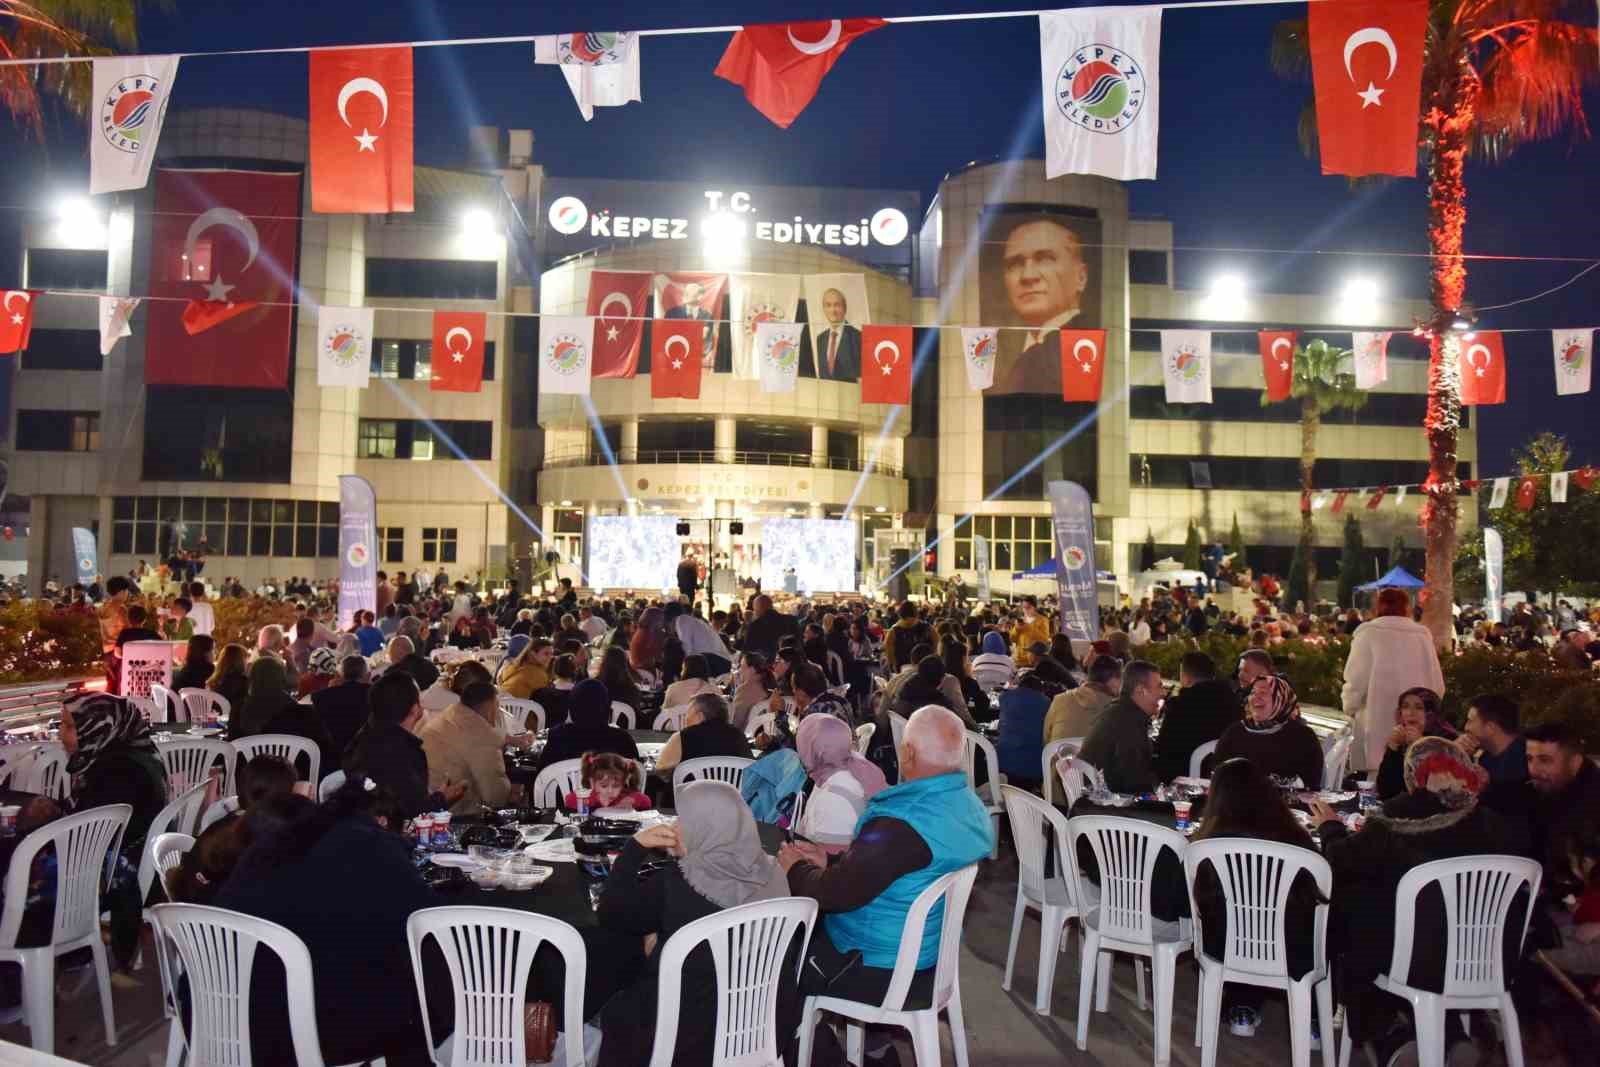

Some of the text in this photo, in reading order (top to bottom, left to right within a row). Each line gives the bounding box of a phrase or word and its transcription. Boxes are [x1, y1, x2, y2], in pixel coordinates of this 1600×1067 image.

[1062, 47, 1138, 81] KEPEZ
[106, 79, 157, 107] KEPE
[1060, 89, 1141, 129] BELEDİYESİ
[590, 213, 870, 247] KEPEZ EDİYESİ
